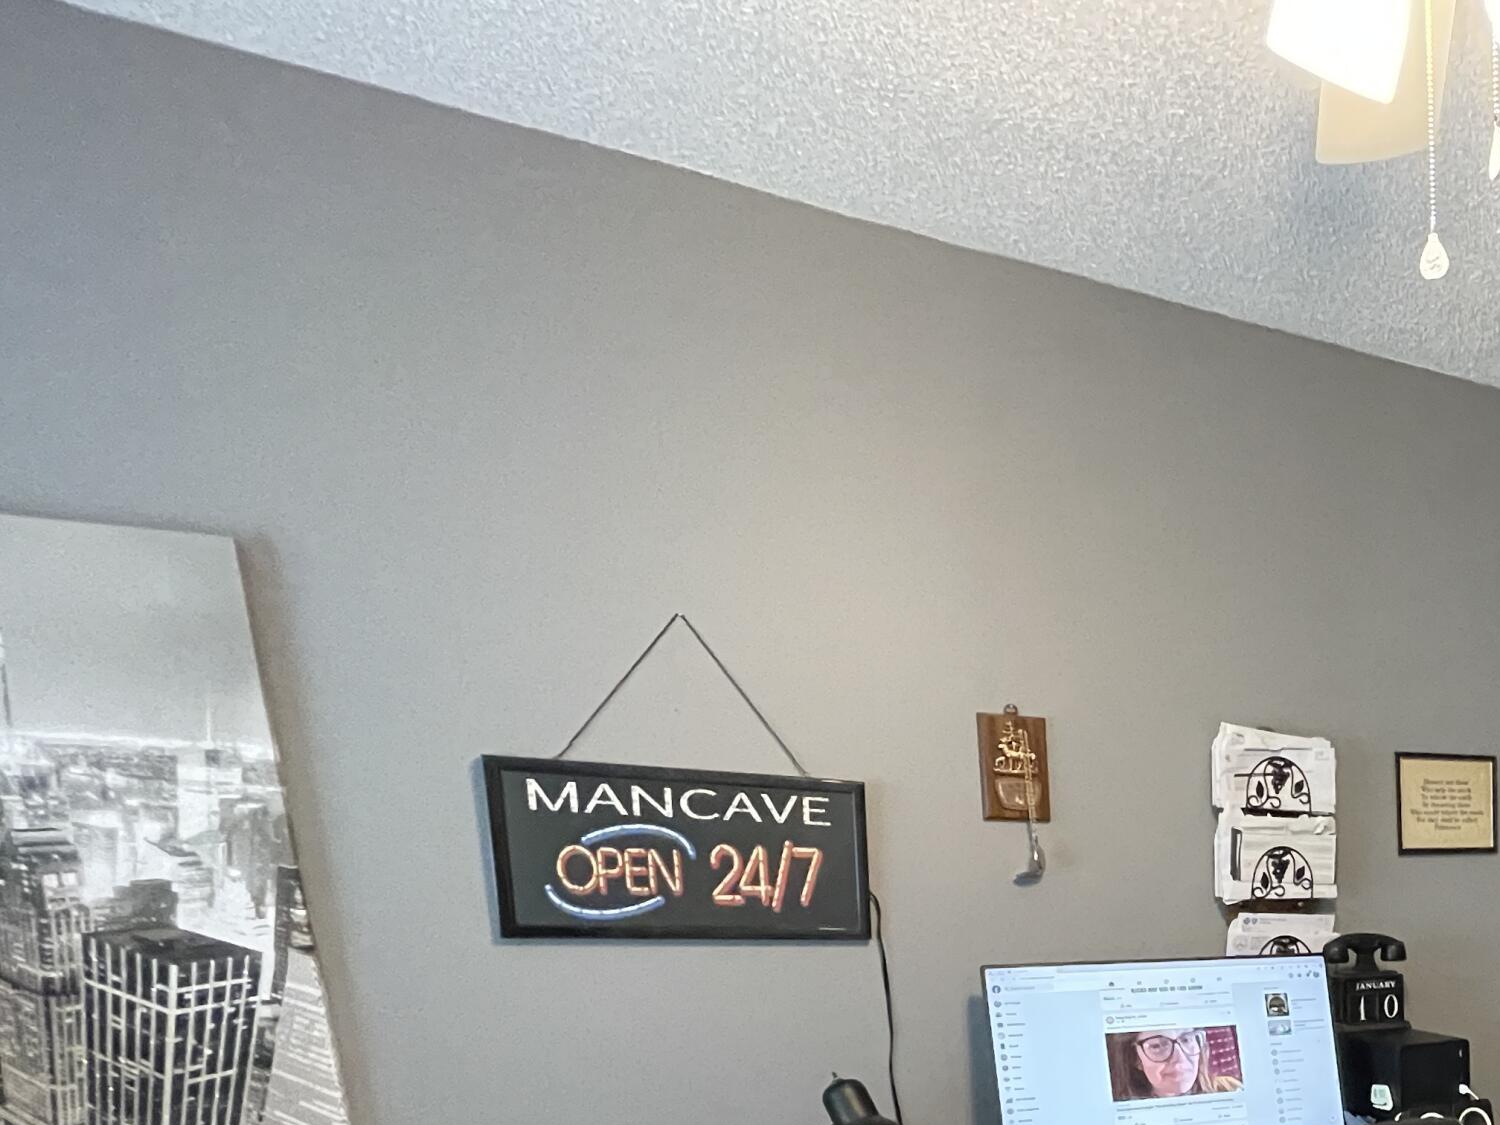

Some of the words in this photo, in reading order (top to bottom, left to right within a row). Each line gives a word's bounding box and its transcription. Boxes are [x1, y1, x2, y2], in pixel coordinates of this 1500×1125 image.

[525, 778, 832, 827] MANCAVE
[555, 843, 684, 897] OPEN
[709, 839, 824, 913] 24/7
[1355, 980, 1396, 991] JANUARY
